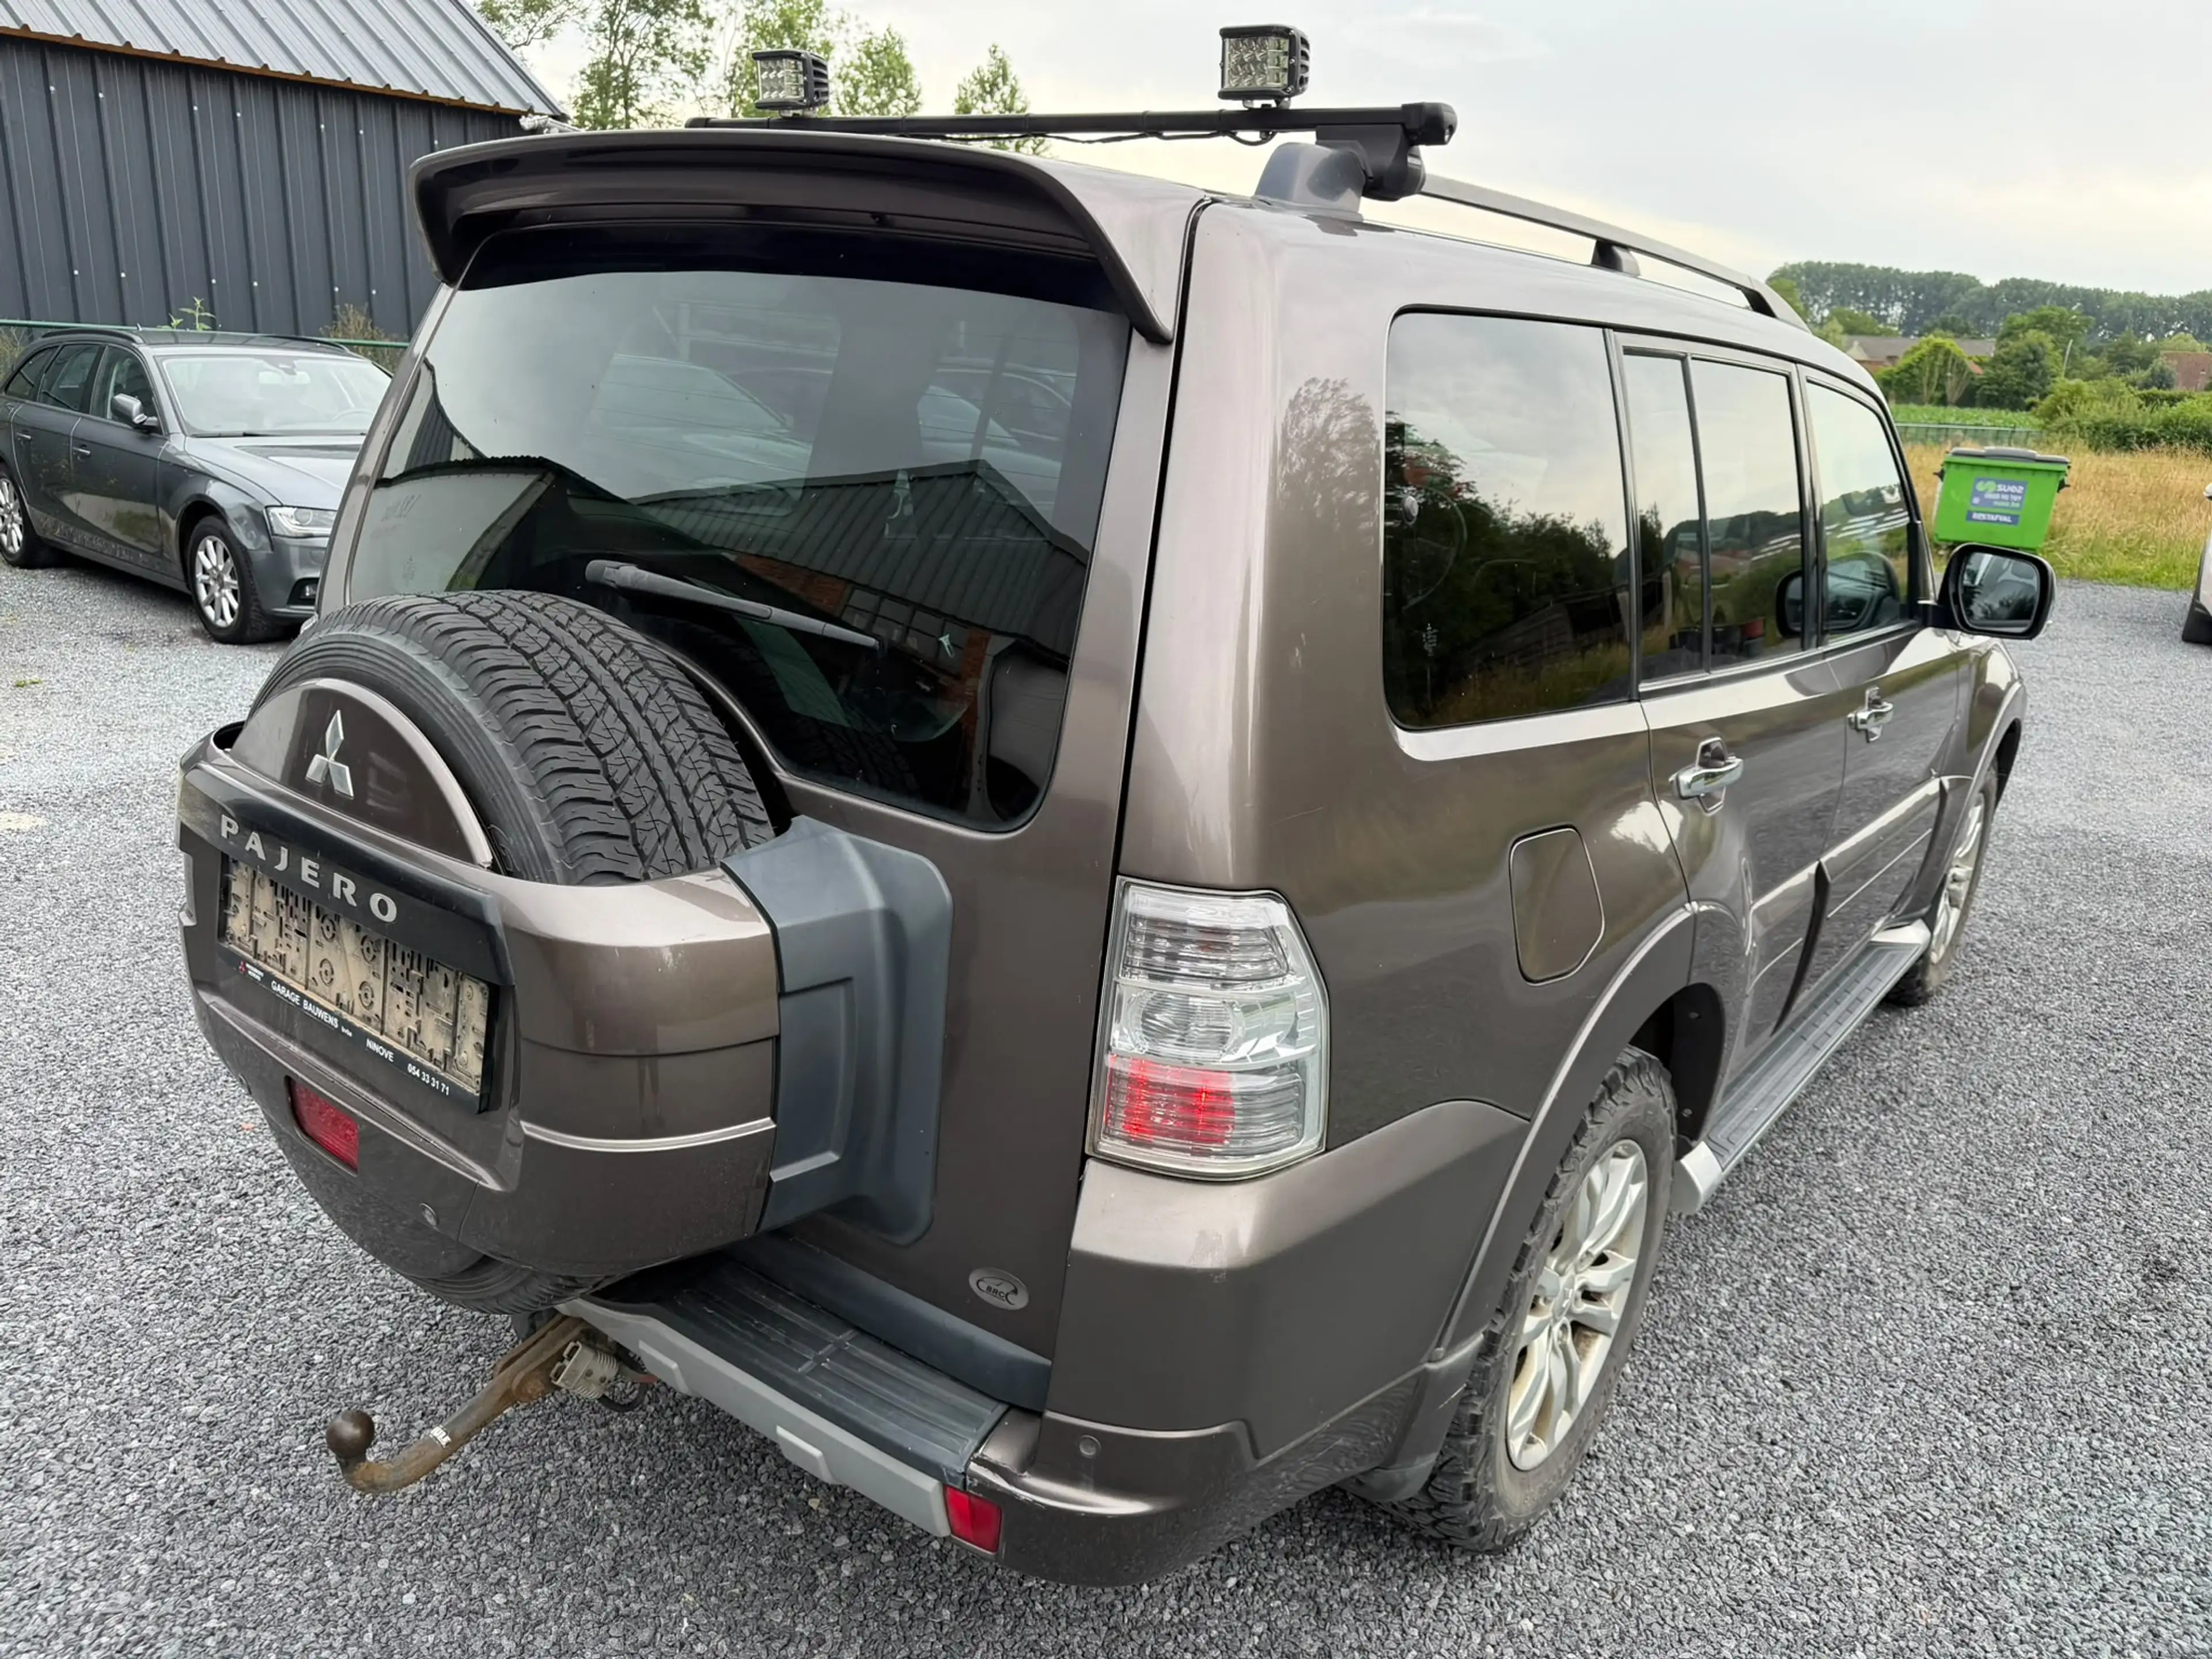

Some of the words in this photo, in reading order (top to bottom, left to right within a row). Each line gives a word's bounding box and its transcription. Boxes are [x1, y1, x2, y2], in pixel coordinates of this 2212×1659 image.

[221, 814, 397, 922] PAJERO
[271, 980, 301, 1006] GARAGE
[302, 999, 339, 1028] BAUWENS
[366, 1037, 395, 1063] NINOVE
[407, 1063, 421, 1078] 054
[421, 1071, 430, 1084] 33
[431, 1077, 440, 1090] 31
[440, 1082, 449, 1096] 71
[986, 1285, 1006, 1298] BRC
